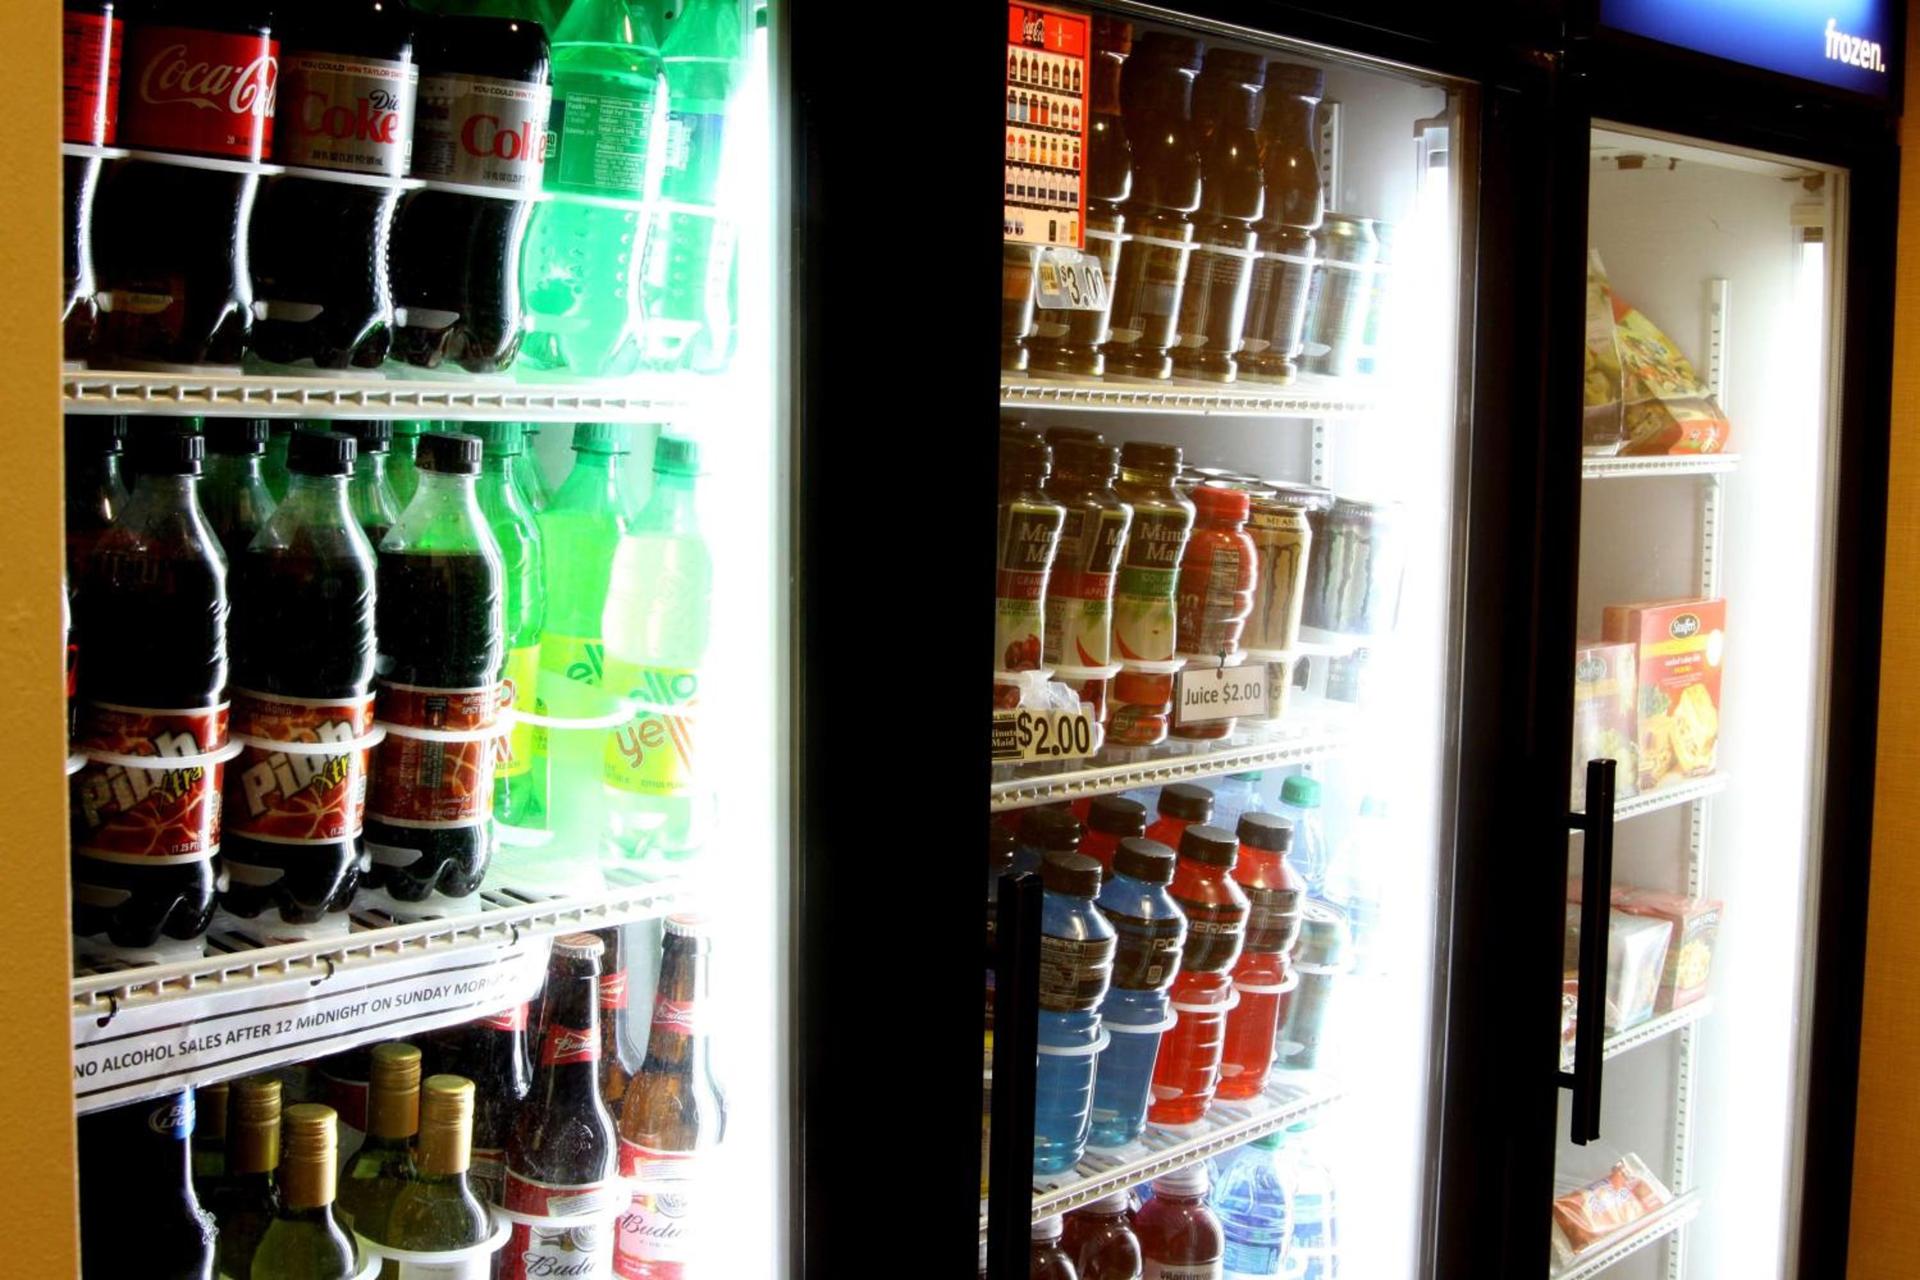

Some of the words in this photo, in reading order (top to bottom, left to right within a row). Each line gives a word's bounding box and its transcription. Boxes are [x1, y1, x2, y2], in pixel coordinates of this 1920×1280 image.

[1825, 18, 1885, 72] frozen.
[490, 86, 514, 96] COULD
[290, 90, 398, 144] Coke
[1184, 687, 1218, 706] Juice
[1223, 682, 1261, 704] $2.00
[1017, 710, 1090, 756] $2.00
[311, 754, 350, 798] Xtr
[74, 1061, 98, 1079] NO
[102, 1045, 174, 1073] ALCOHOL
[178, 1033, 222, 1056] SALES
[225, 1022, 271, 1045] AFTER
[275, 1019, 292, 1034] 12
[371, 996, 392, 1012] ON
[394, 984, 452, 1007] SUNDAY
